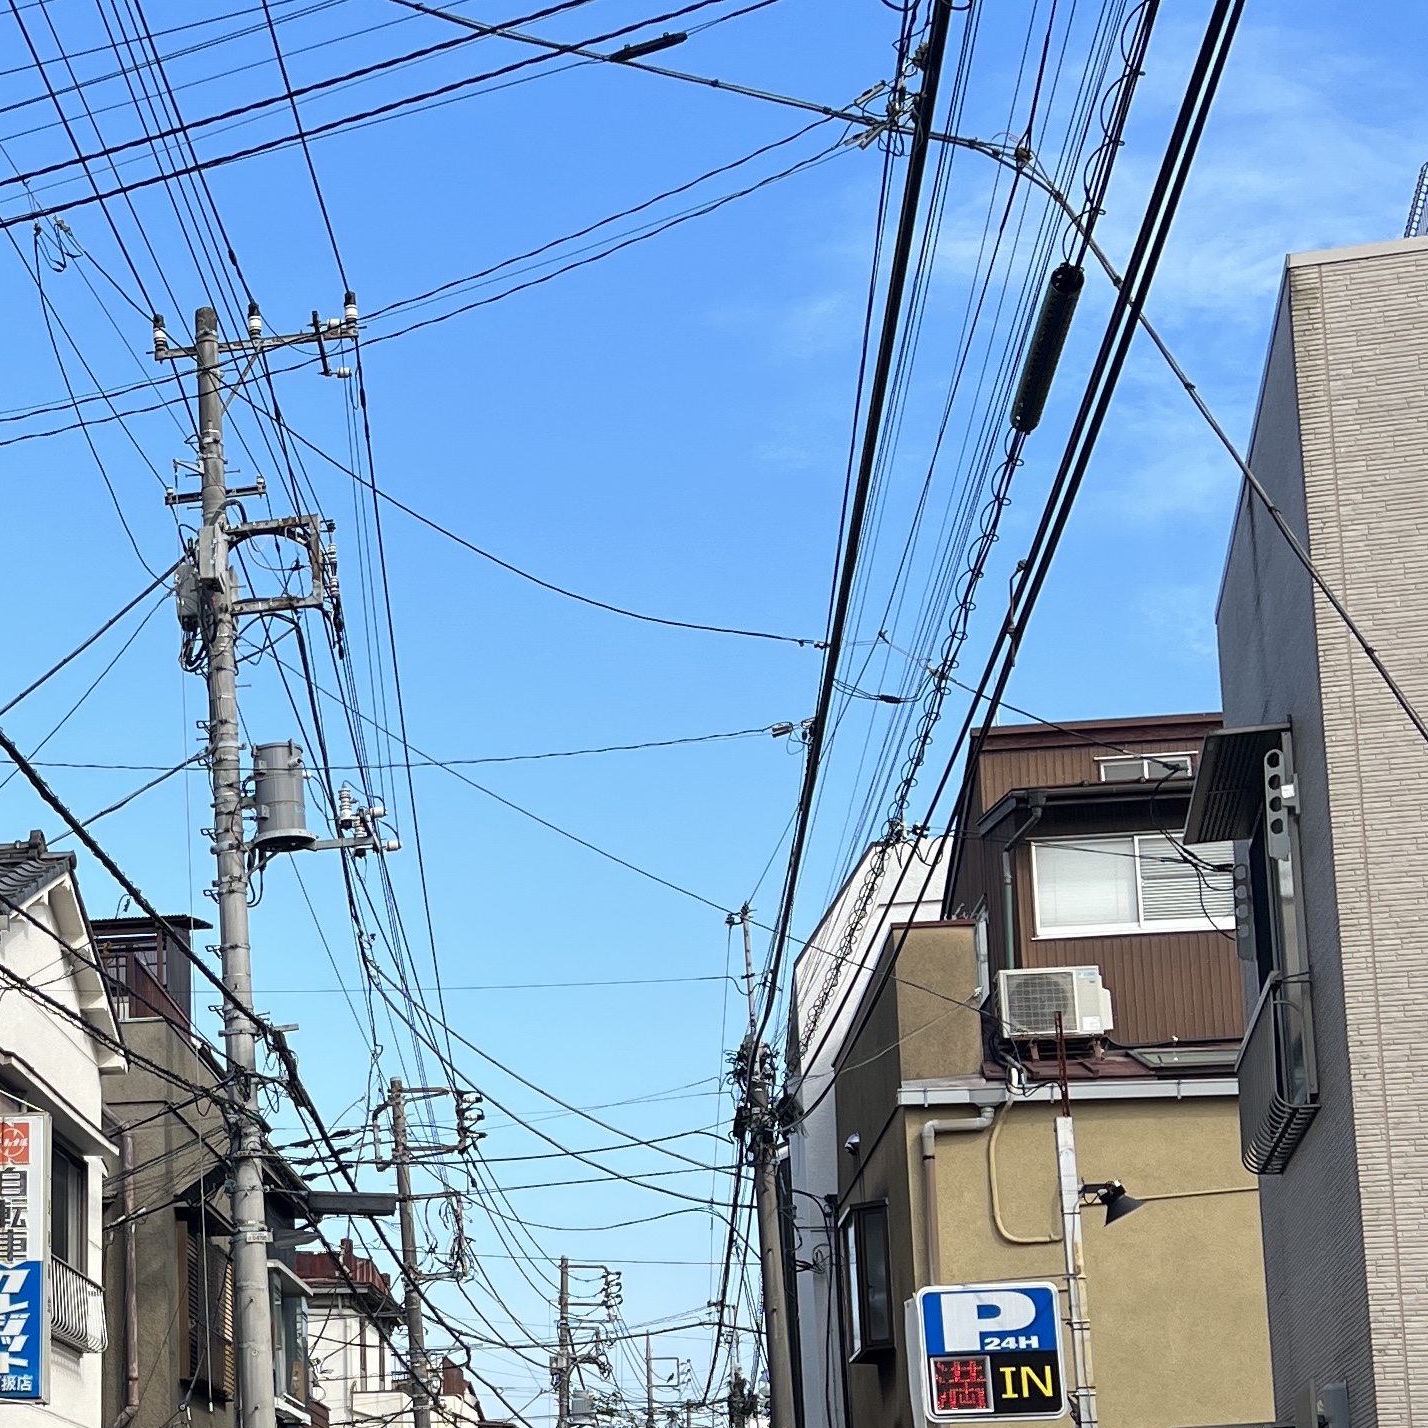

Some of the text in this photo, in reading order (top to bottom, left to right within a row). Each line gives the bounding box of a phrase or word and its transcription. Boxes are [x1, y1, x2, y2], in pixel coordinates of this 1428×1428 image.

[940, 1290, 1036, 1353] P
[984, 1335, 1039, 1350] 24H
[999, 1365, 1054, 1399] IN
